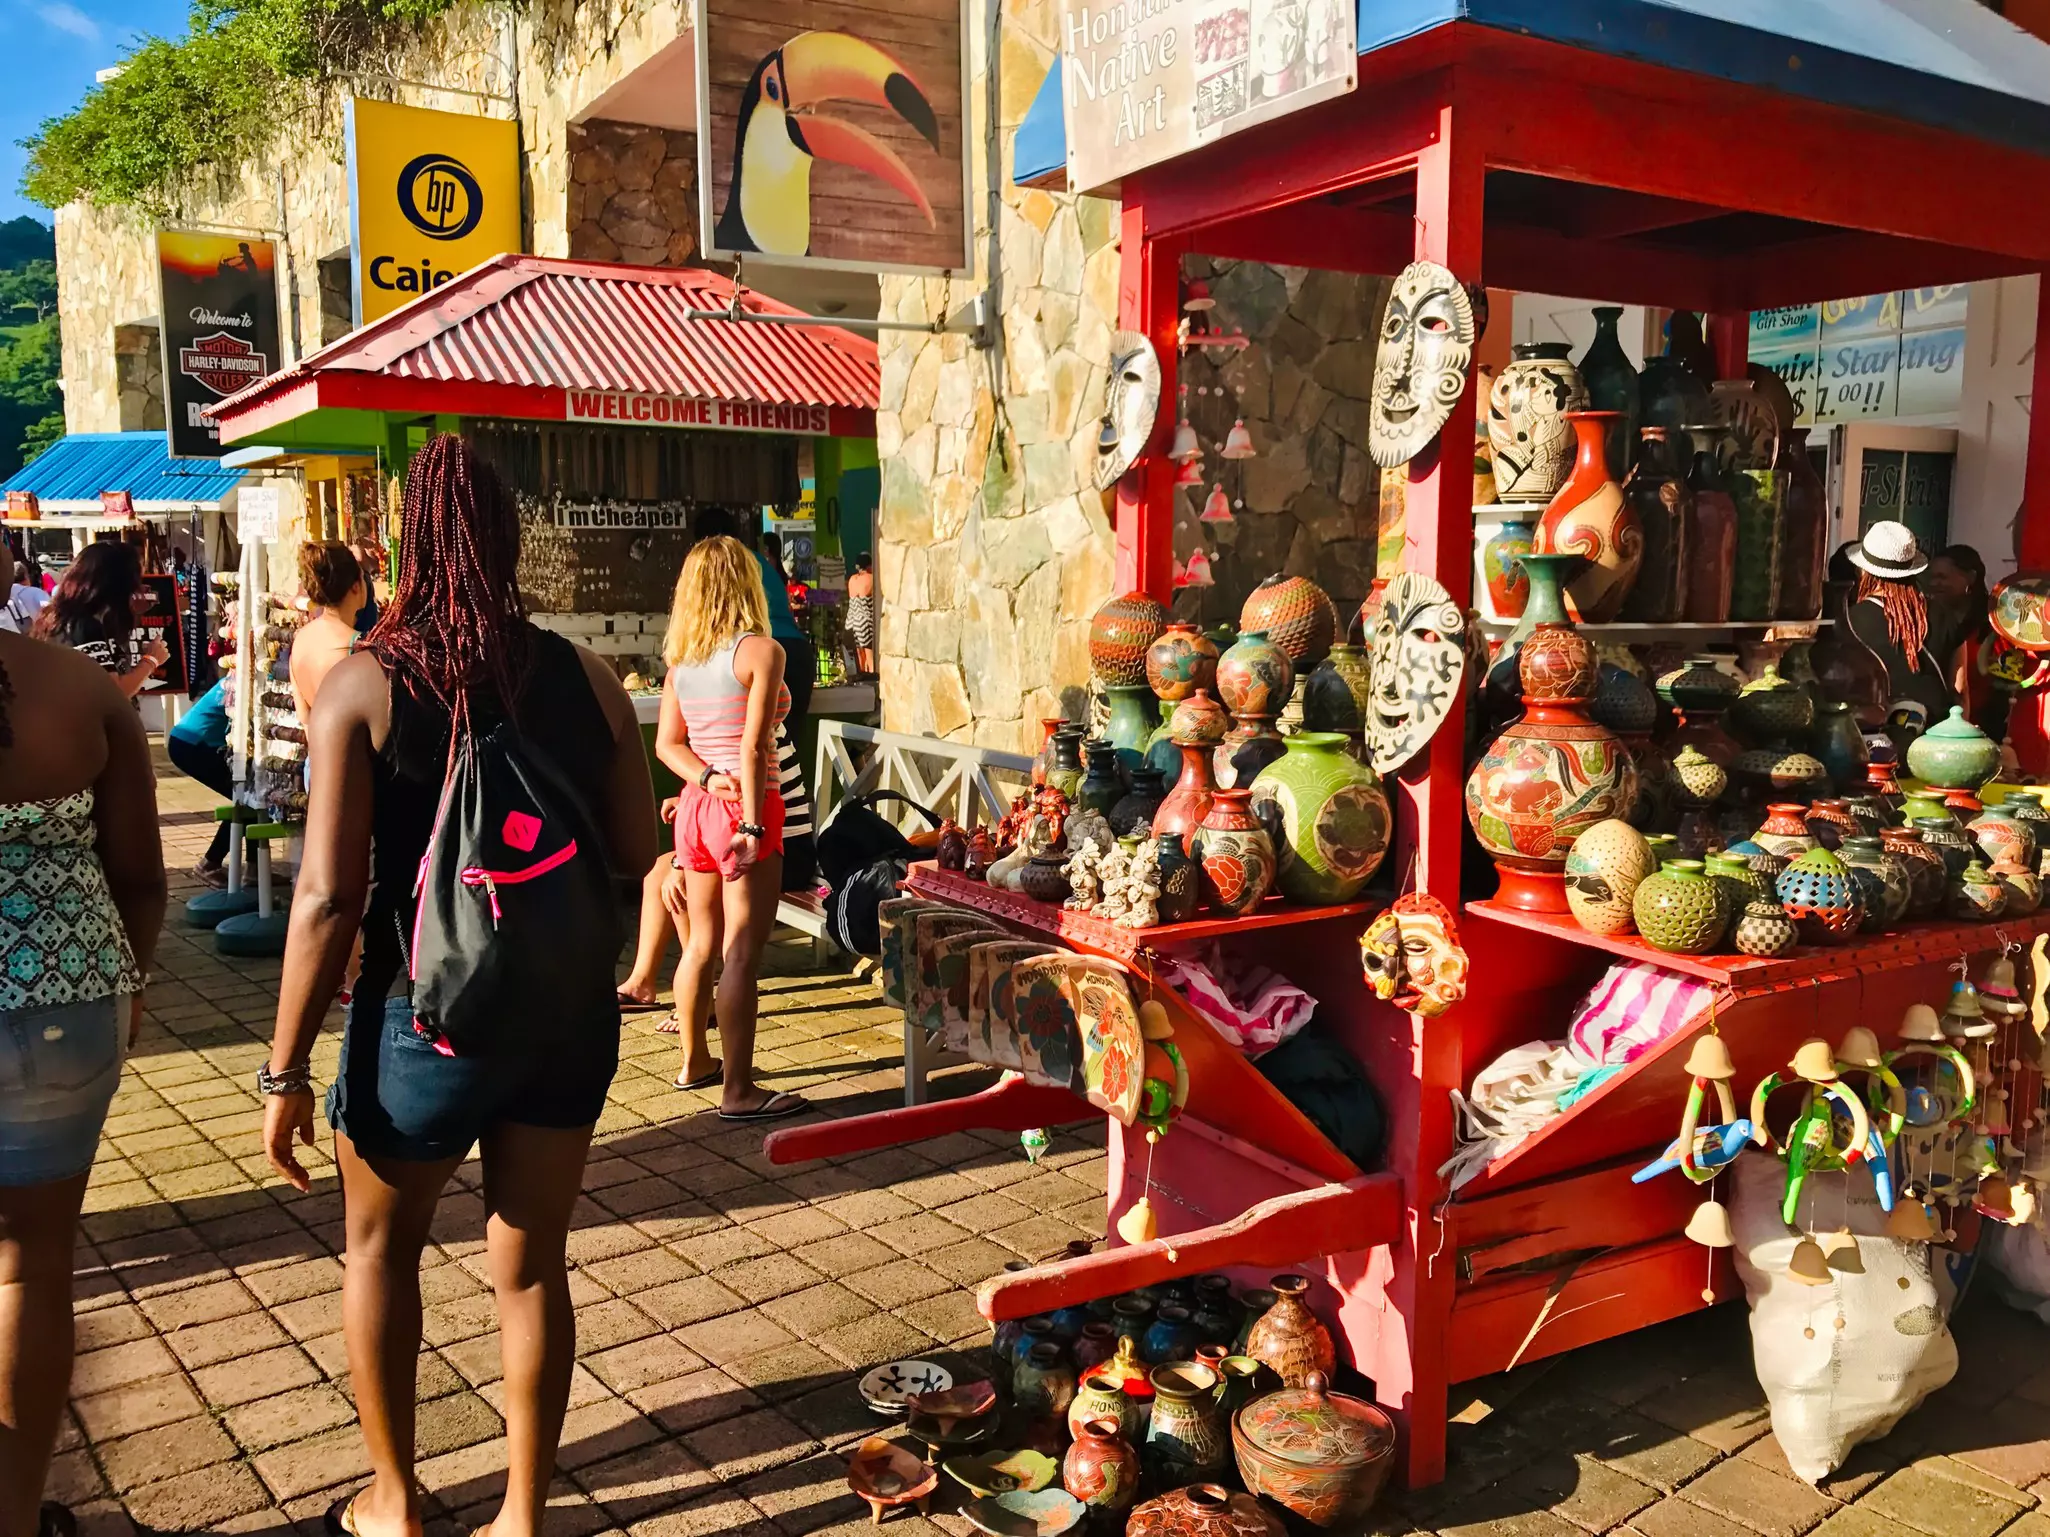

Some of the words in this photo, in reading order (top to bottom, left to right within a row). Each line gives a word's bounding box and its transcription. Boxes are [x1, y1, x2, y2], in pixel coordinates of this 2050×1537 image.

[1071, 27, 1177, 109] Native
[1114, 84, 1167, 147] Art
[369, 255, 466, 295] Caje
[189, 306, 241, 326] Welcome
[240, 312, 253, 328] to
[1756, 313, 1776, 331] Gift
[1779, 313, 1808, 328] Shop
[204, 341, 243, 354] MOTOR
[1831, 338, 1960, 379] Starting
[187, 355, 260, 372] HARLEY-DAVIDSON
[205, 373, 244, 390] CYCLES
[570, 392, 712, 425] WELCOME
[718, 402, 827, 432] FRIENDS
[591, 507, 683, 527] Cheaper
